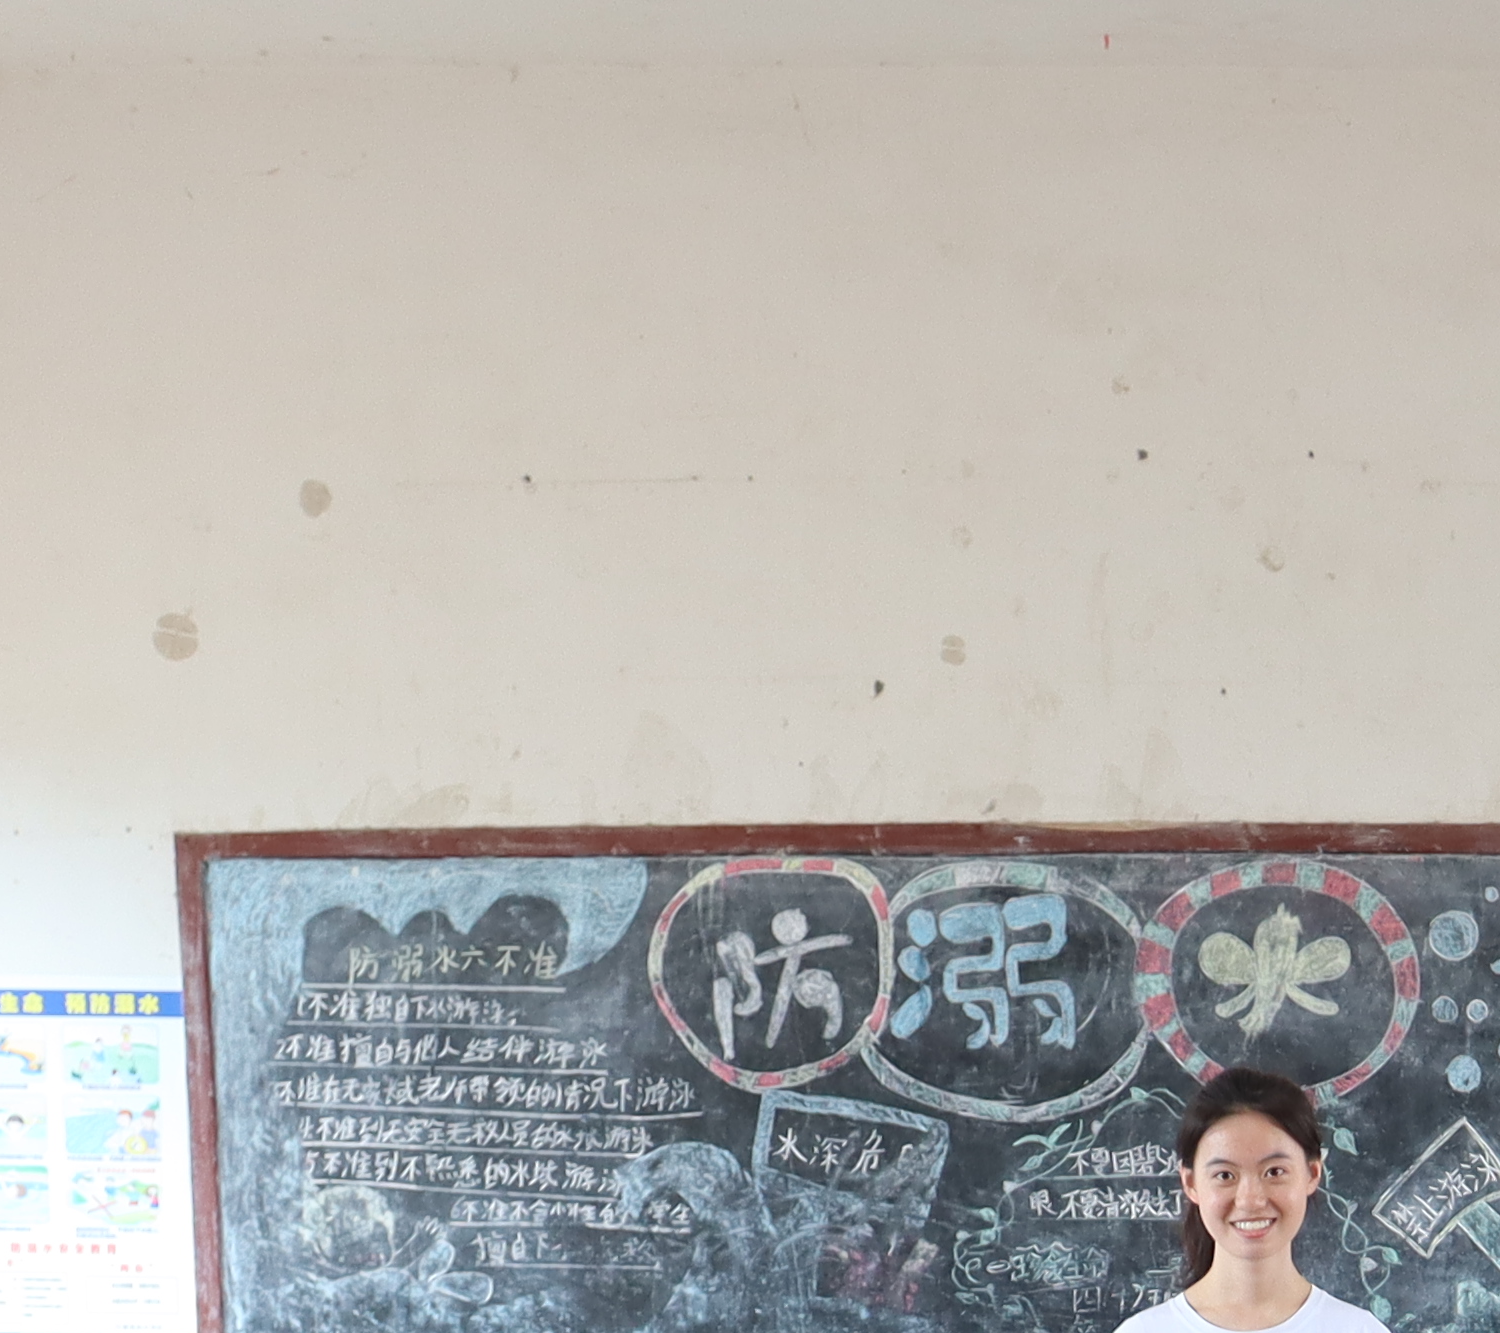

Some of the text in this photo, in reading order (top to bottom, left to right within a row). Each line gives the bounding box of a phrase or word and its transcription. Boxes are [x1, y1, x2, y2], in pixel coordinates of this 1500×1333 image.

[348, 938, 560, 983] 防溺水六不准
[772, 1128, 914, 1176] 水深危
